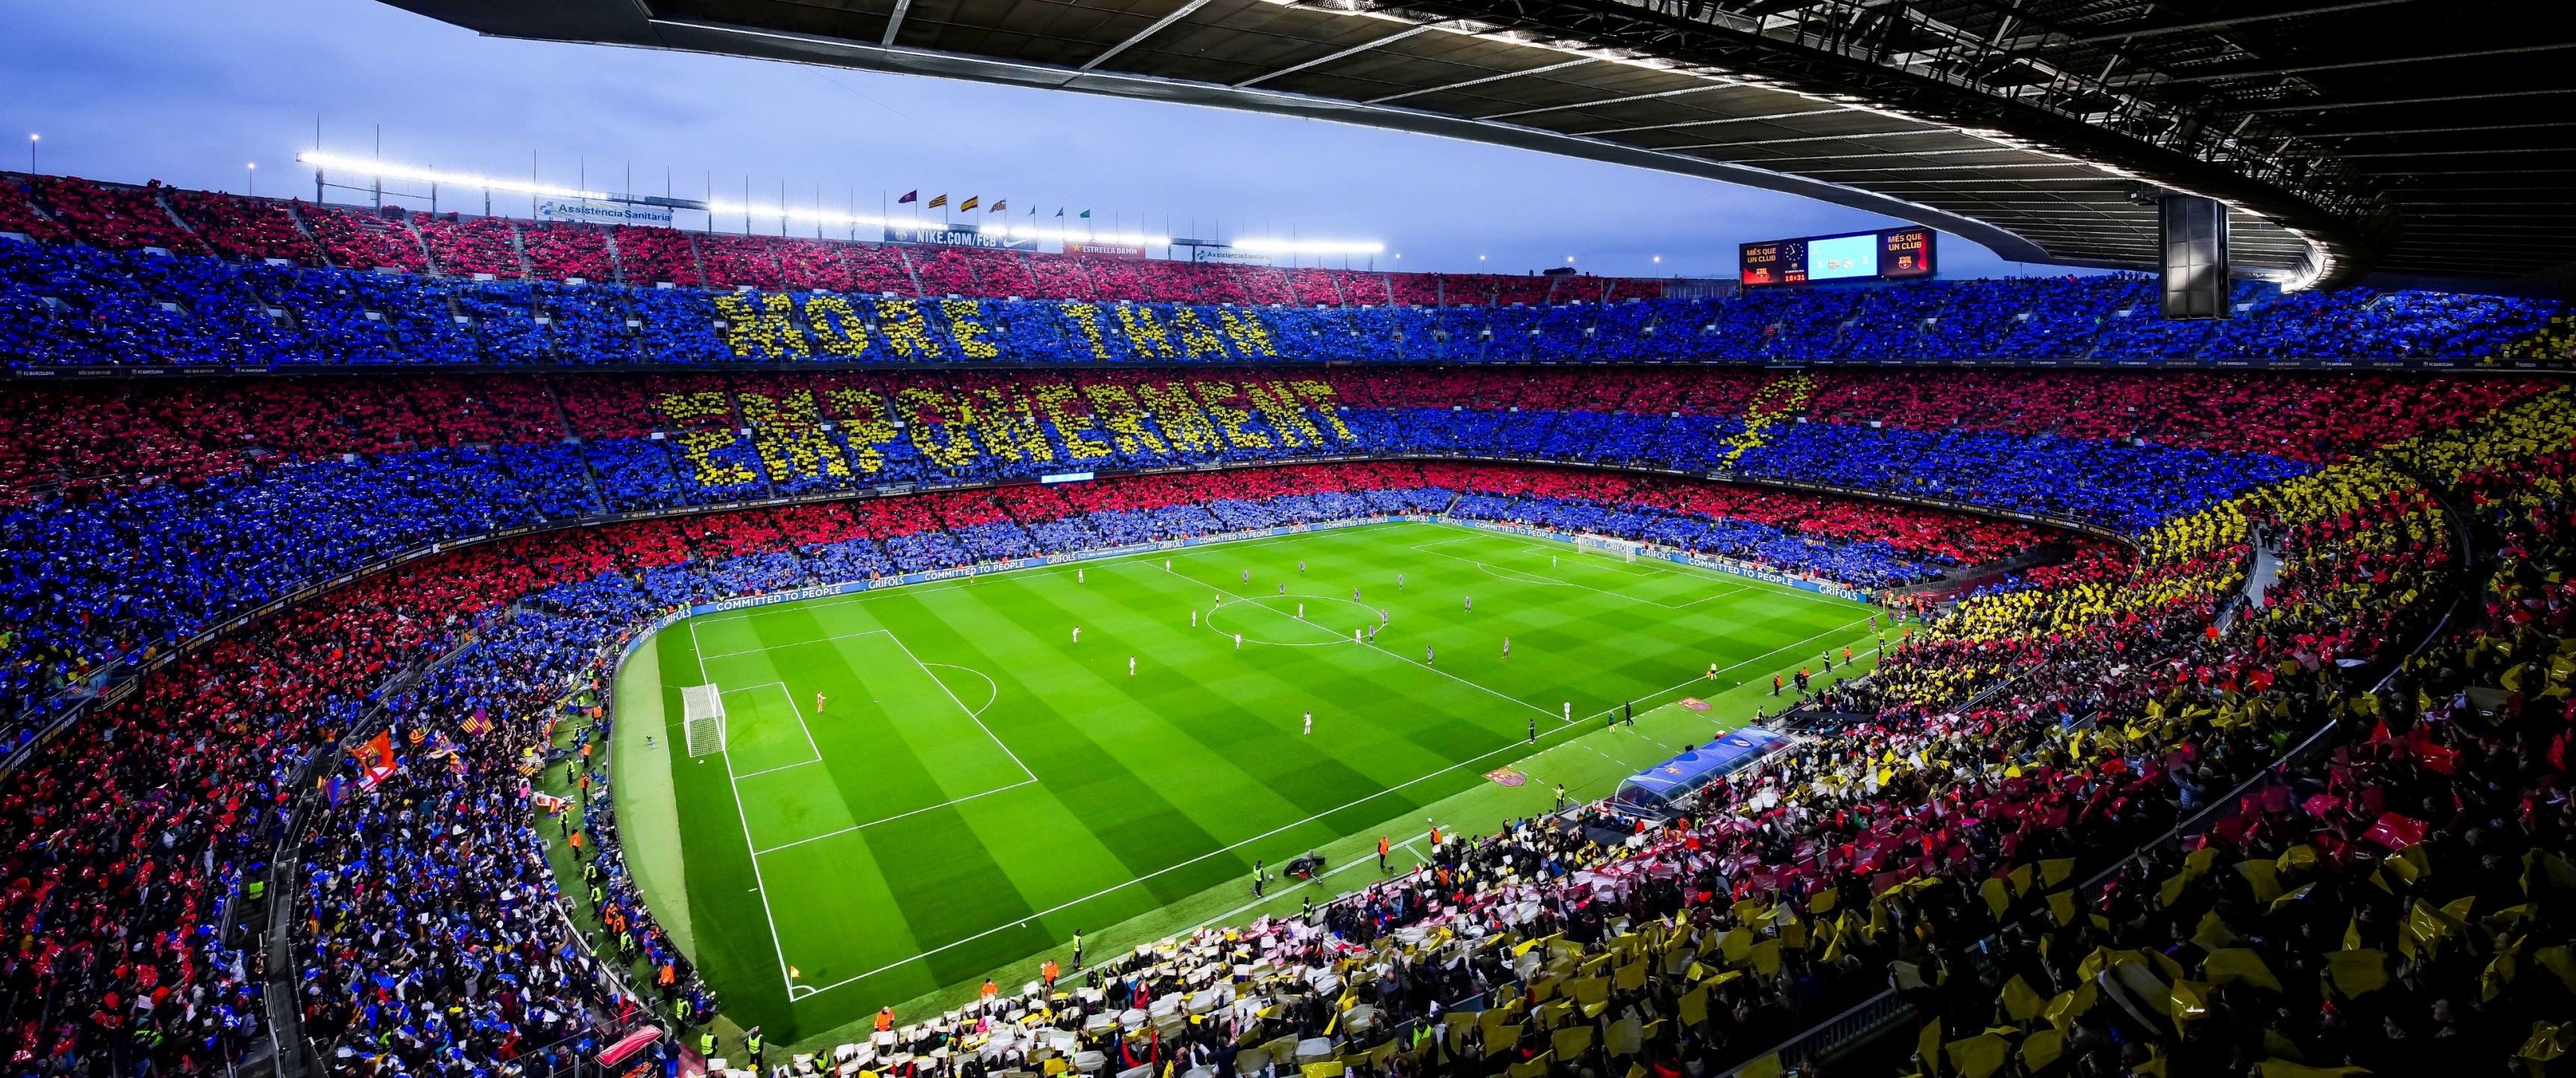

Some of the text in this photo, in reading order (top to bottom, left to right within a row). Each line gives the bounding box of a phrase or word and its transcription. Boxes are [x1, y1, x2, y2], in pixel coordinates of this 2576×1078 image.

[559, 204, 671, 222] Assistència Sanitària
[917, 229, 997, 247] NIKE.COM/FCB
[1888, 232, 1922, 243] MÉS QUE
[1083, 246, 1116, 254] ESTRELLA
[1762, 247, 1776, 255] QUE
[1889, 241, 1922, 251] UN CLUB
[714, 292, 1277, 360] MORE THAN
[659, 380, 1356, 487] EMPOWERMENT
[1323, 520, 1357, 529] COMMITTED
[1405, 514, 1430, 523] GRIFOLS
[1437, 517, 1462, 526] GRIFOLS
[1198, 534, 1236, 544] COMMITTED
[1249, 529, 1273, 538] PEOPLE
[1289, 526, 1311, 534] GRIFOLS
[1474, 521, 1554, 539] COMMITTED TO PEOPLE
[1158, 540, 1185, 550] GRIFOLS
[1570, 536, 1597, 547] GRIFOLS
[1604, 541, 1634, 554] GRIFOLS
[1046, 552, 1076, 564] GRIFOLS
[1640, 548, 1671, 561] GRIFOLS
[924, 561, 1025, 581] COMMITTED TO PEOPLE
[1688, 558, 1794, 587] COMMITTED TO PEOPLE
[868, 576, 904, 589] GRIFOLS
[716, 585, 842, 611] COMMITTED TO PEOPLE
[1818, 584, 1858, 601] GRIFOLS
[663, 608, 691, 627] GRIFOLS
[639, 623, 657, 643] GRIFOLS
